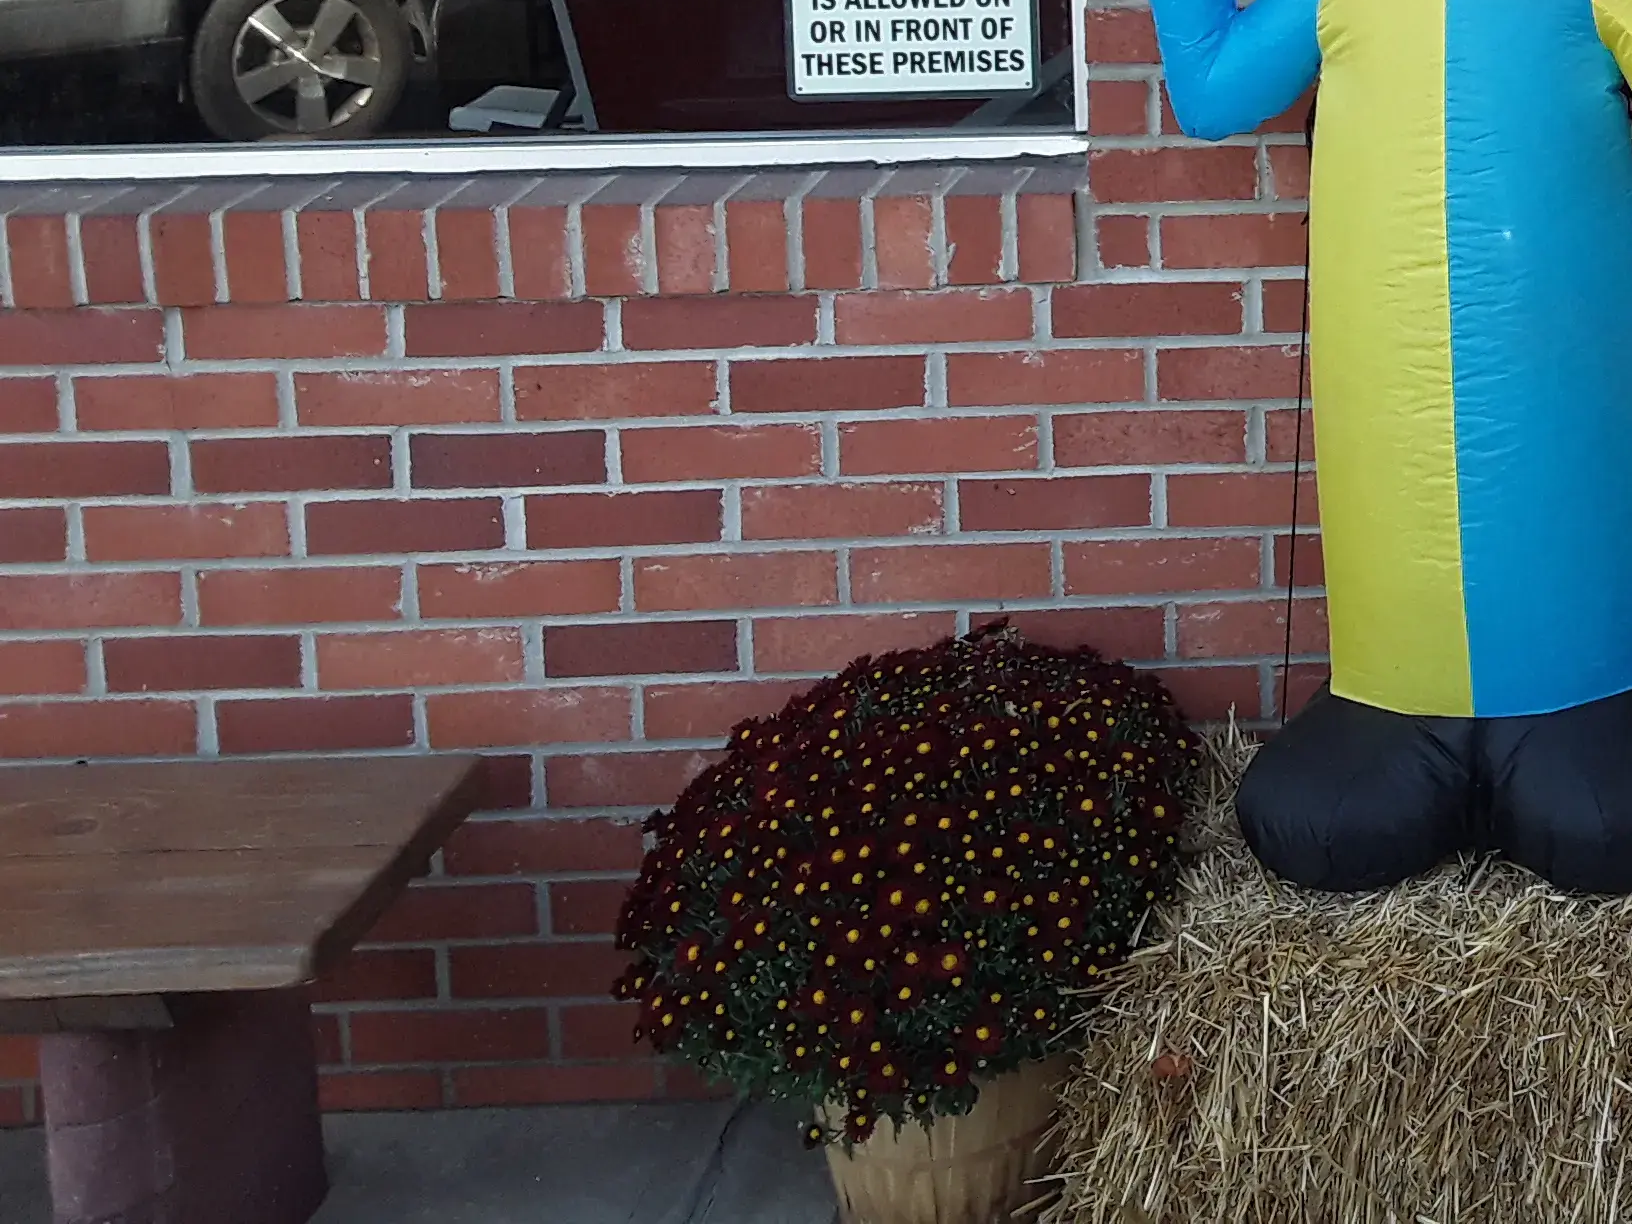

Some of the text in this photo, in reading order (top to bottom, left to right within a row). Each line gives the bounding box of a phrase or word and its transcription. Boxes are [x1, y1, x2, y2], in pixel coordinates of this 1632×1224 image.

[810, 17, 1014, 43] OR IN FRONT OF
[801, 49, 1025, 76] THESE PREMISES
